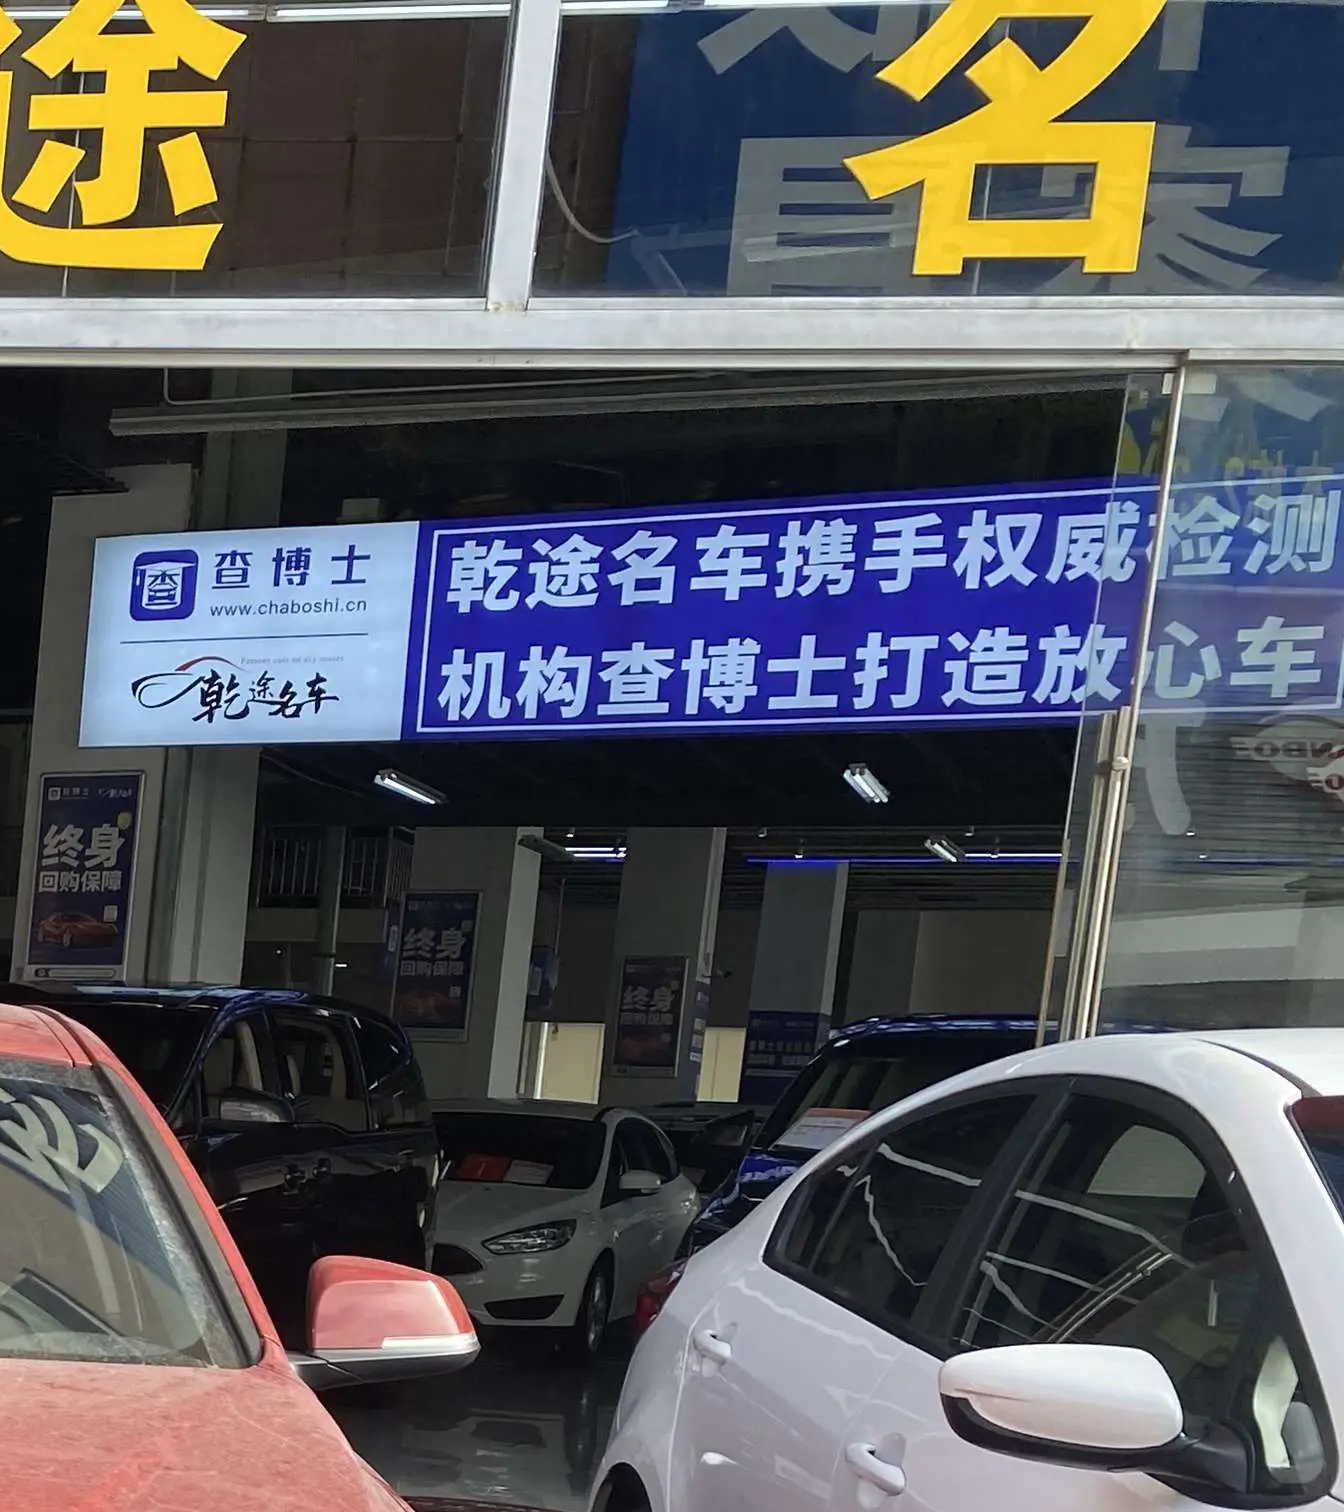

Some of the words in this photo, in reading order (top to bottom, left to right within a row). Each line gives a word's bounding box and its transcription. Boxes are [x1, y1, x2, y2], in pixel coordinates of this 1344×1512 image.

[843, 0, 1170, 276] 名
[211, 543, 372, 590] 查博士
[445, 490, 1342, 614] 乾途名车携手权威检测
[209, 596, 368, 618] www.chaboshi.cn
[437, 615, 1327, 723] 机构查博士打造放心车
[192, 668, 340, 724] 乾途名车
[41, 823, 126, 869] 终身
[38, 870, 123, 894] 回购保障
[402, 926, 467, 960] 终身
